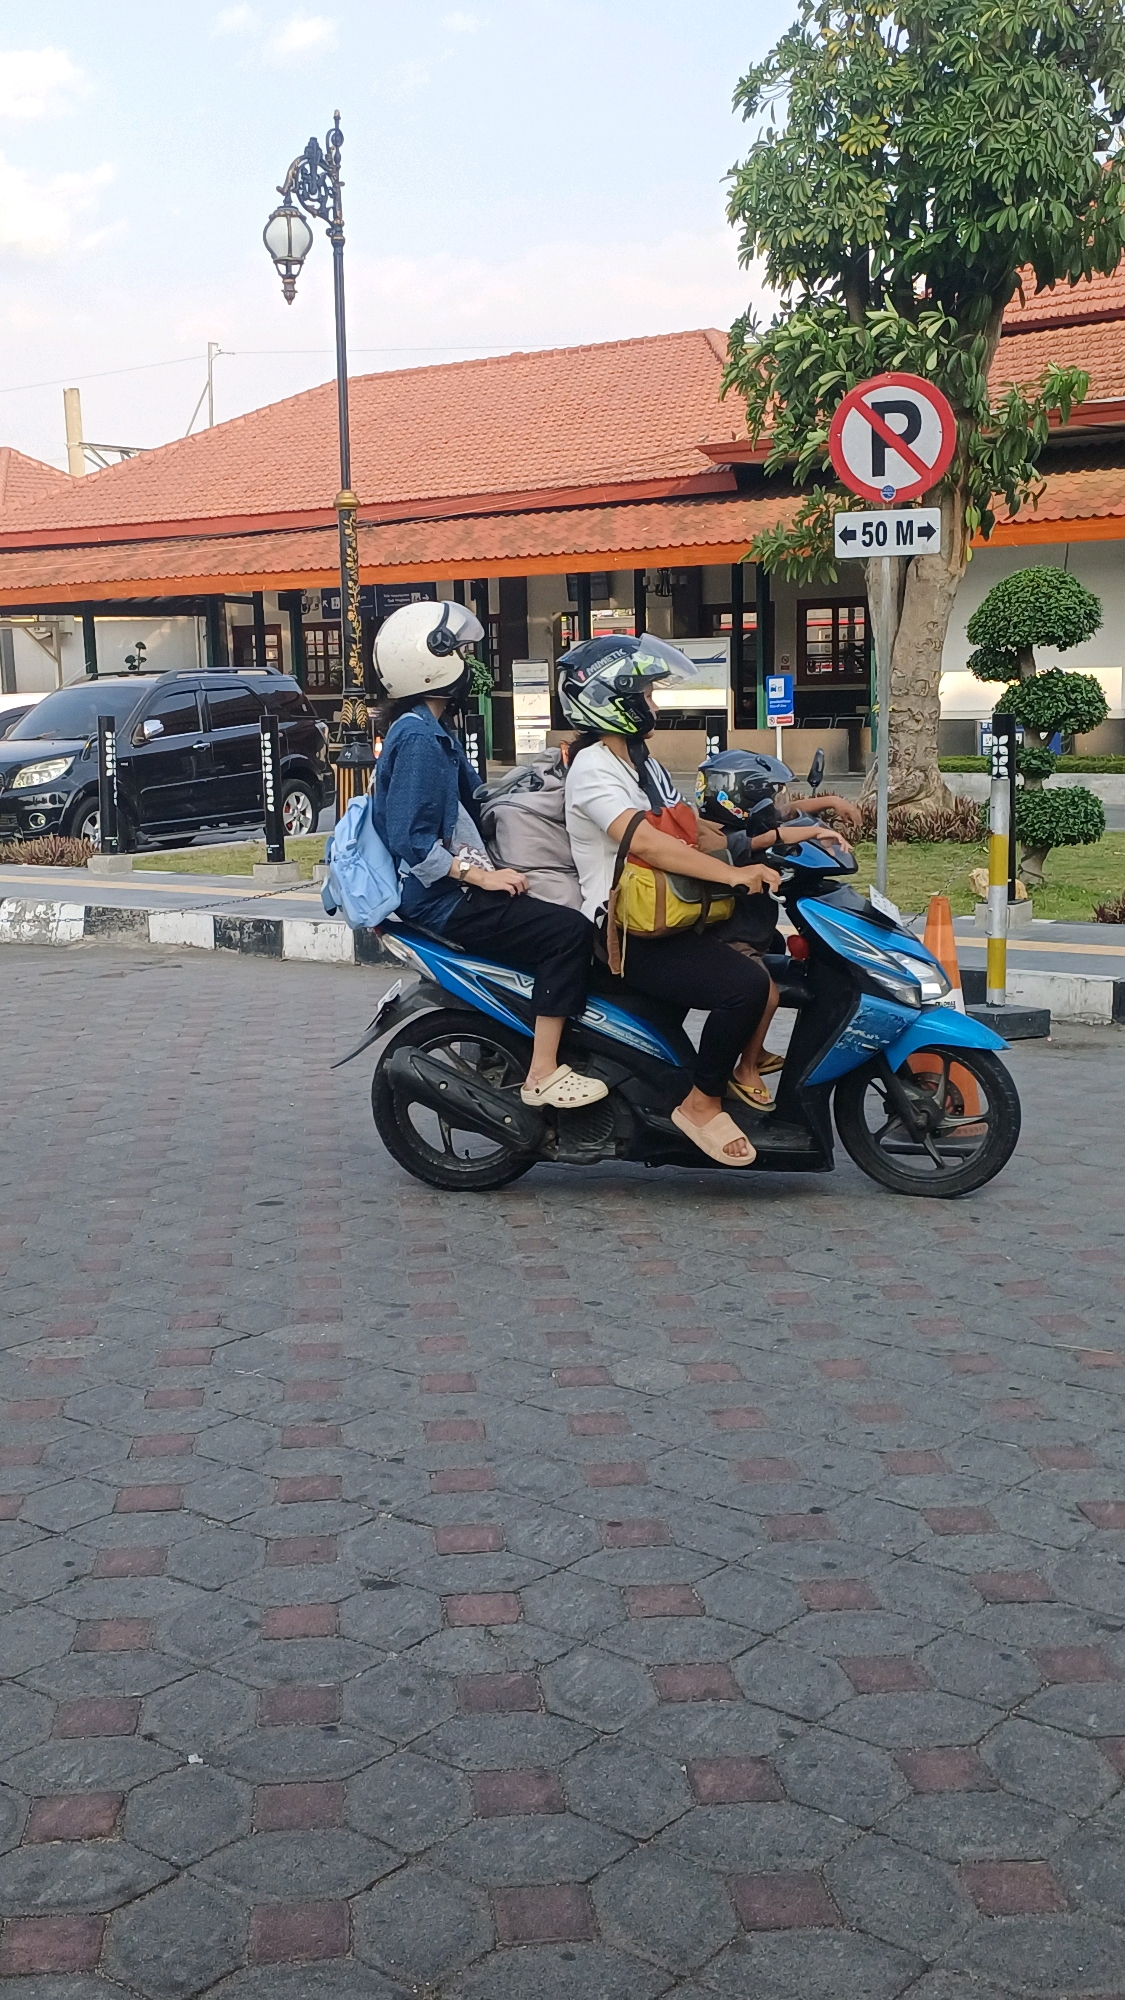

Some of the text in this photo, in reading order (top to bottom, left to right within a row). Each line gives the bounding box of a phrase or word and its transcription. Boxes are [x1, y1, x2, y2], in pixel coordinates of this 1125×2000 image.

[871, 400, 922, 477] P
[861, 520, 914, 547] 50 M
[585, 648, 627, 676] MIMETIC
